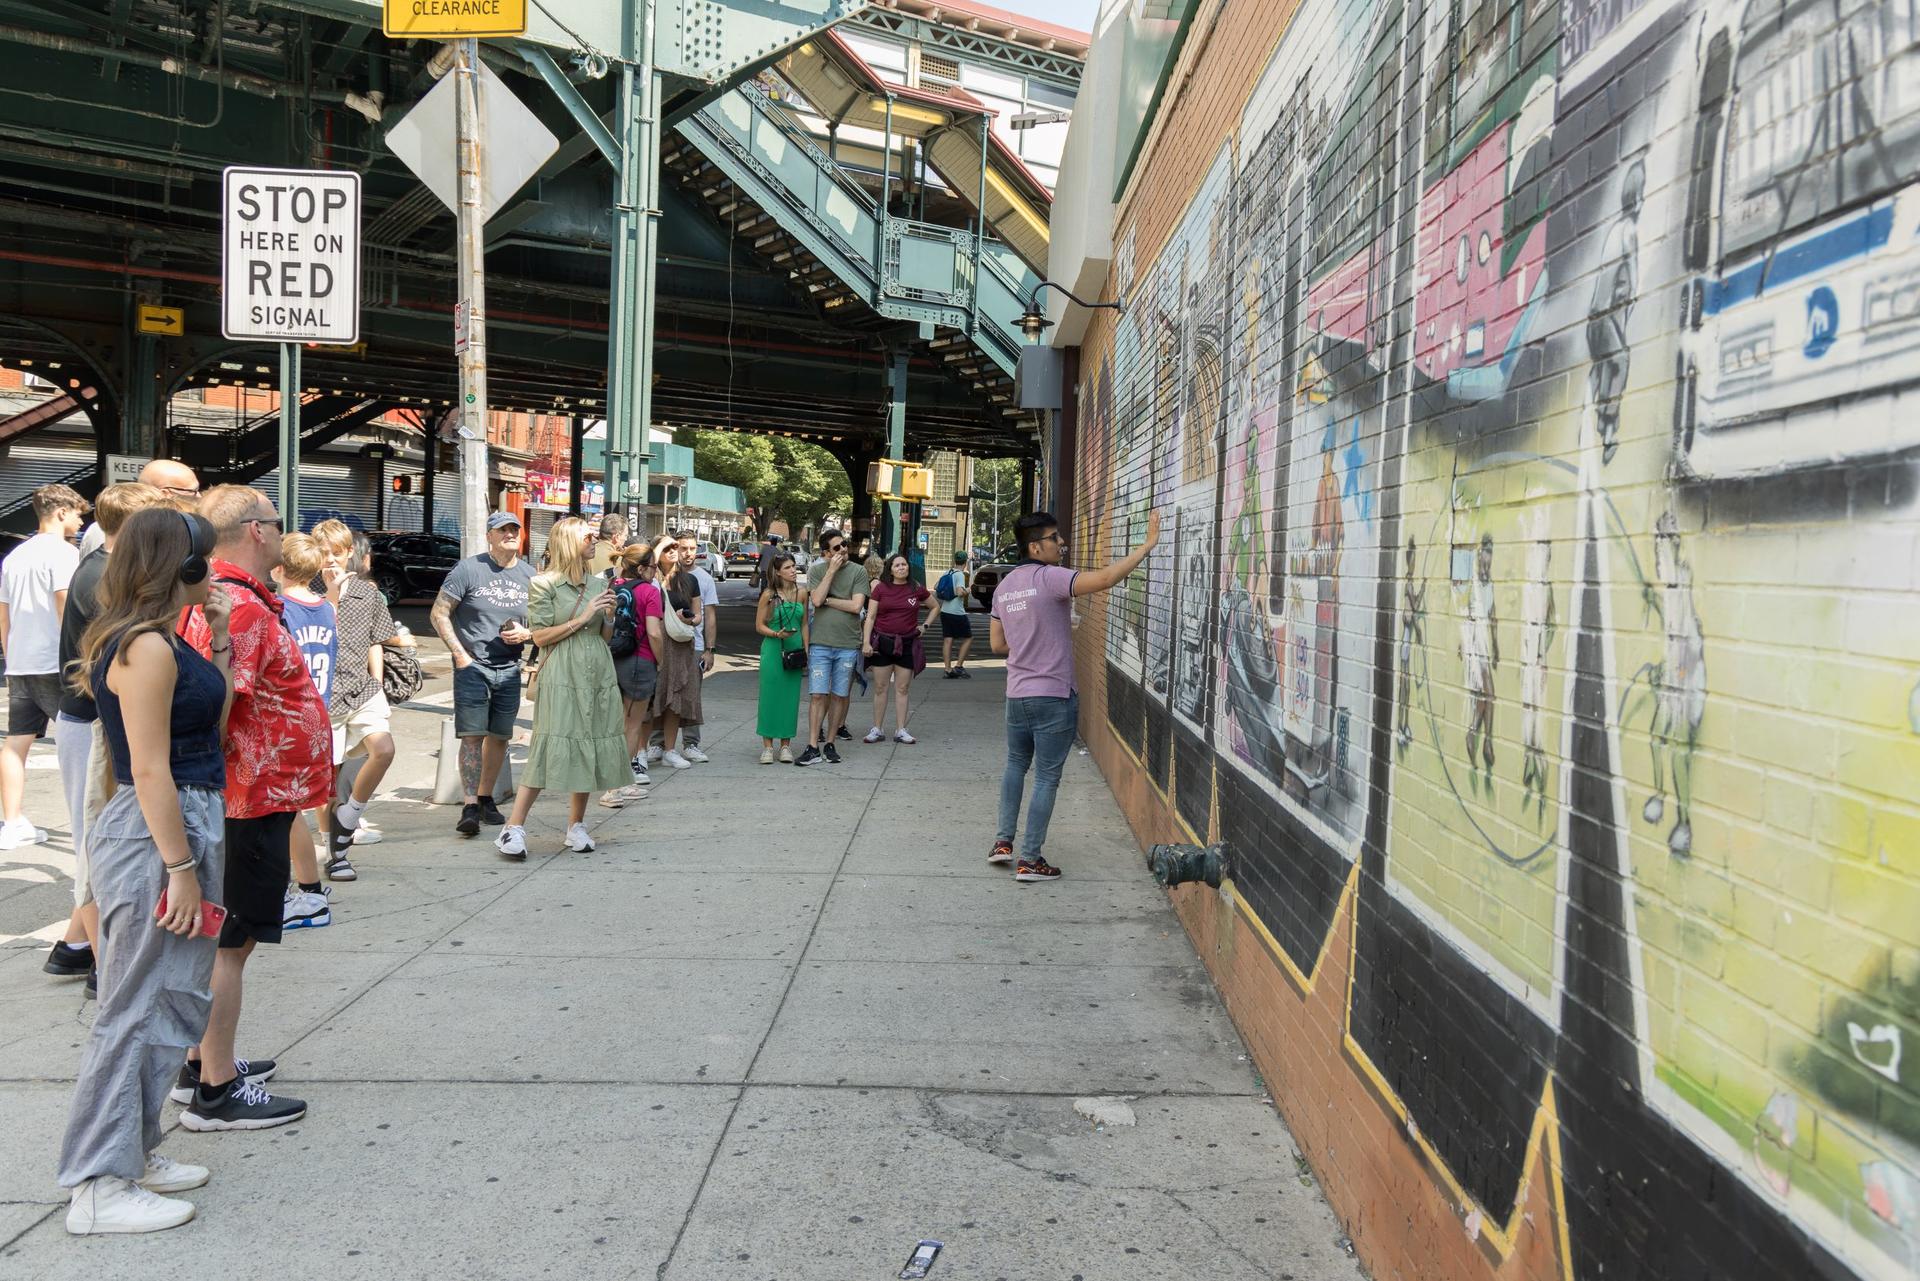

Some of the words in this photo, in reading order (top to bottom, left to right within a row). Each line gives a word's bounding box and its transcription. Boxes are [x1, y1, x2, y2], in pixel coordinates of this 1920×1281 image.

[412, 0, 500, 16] CLEARANCE
[237, 184, 347, 224] STOP
[240, 231, 299, 251] HERE
[314, 234, 343, 253] ON
[248, 260, 334, 298] RED
[251, 306, 331, 327] SIGNAL
